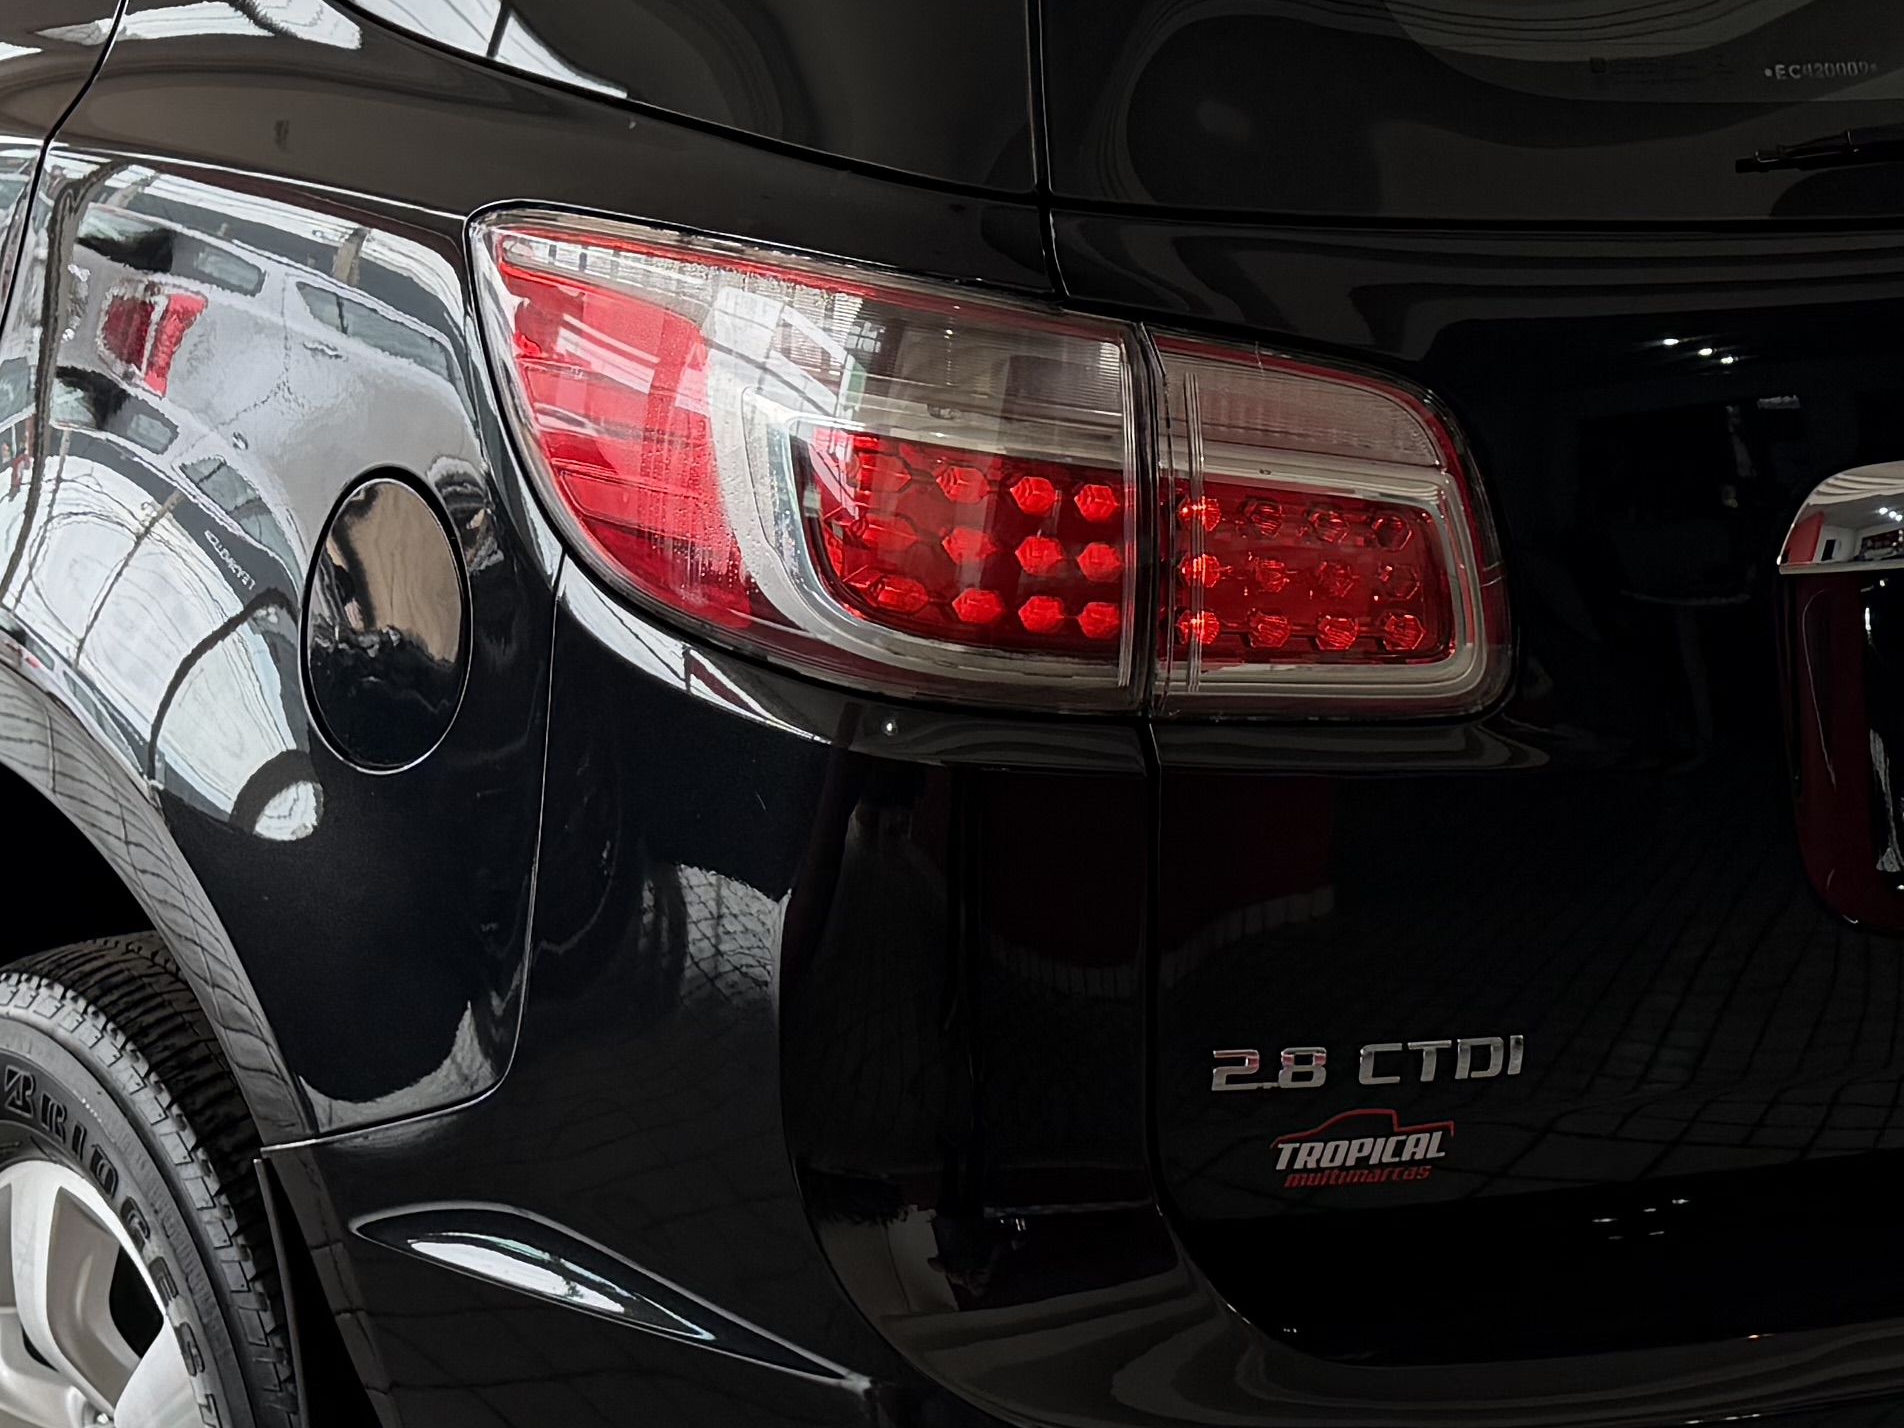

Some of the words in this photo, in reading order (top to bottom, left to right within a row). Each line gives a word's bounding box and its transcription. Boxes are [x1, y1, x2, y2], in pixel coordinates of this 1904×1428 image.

[1211, 1046, 1327, 1091] 2.8
[1274, 1130, 1446, 1171] TROPICAL
[1283, 1164, 1432, 1189] multimarcas
